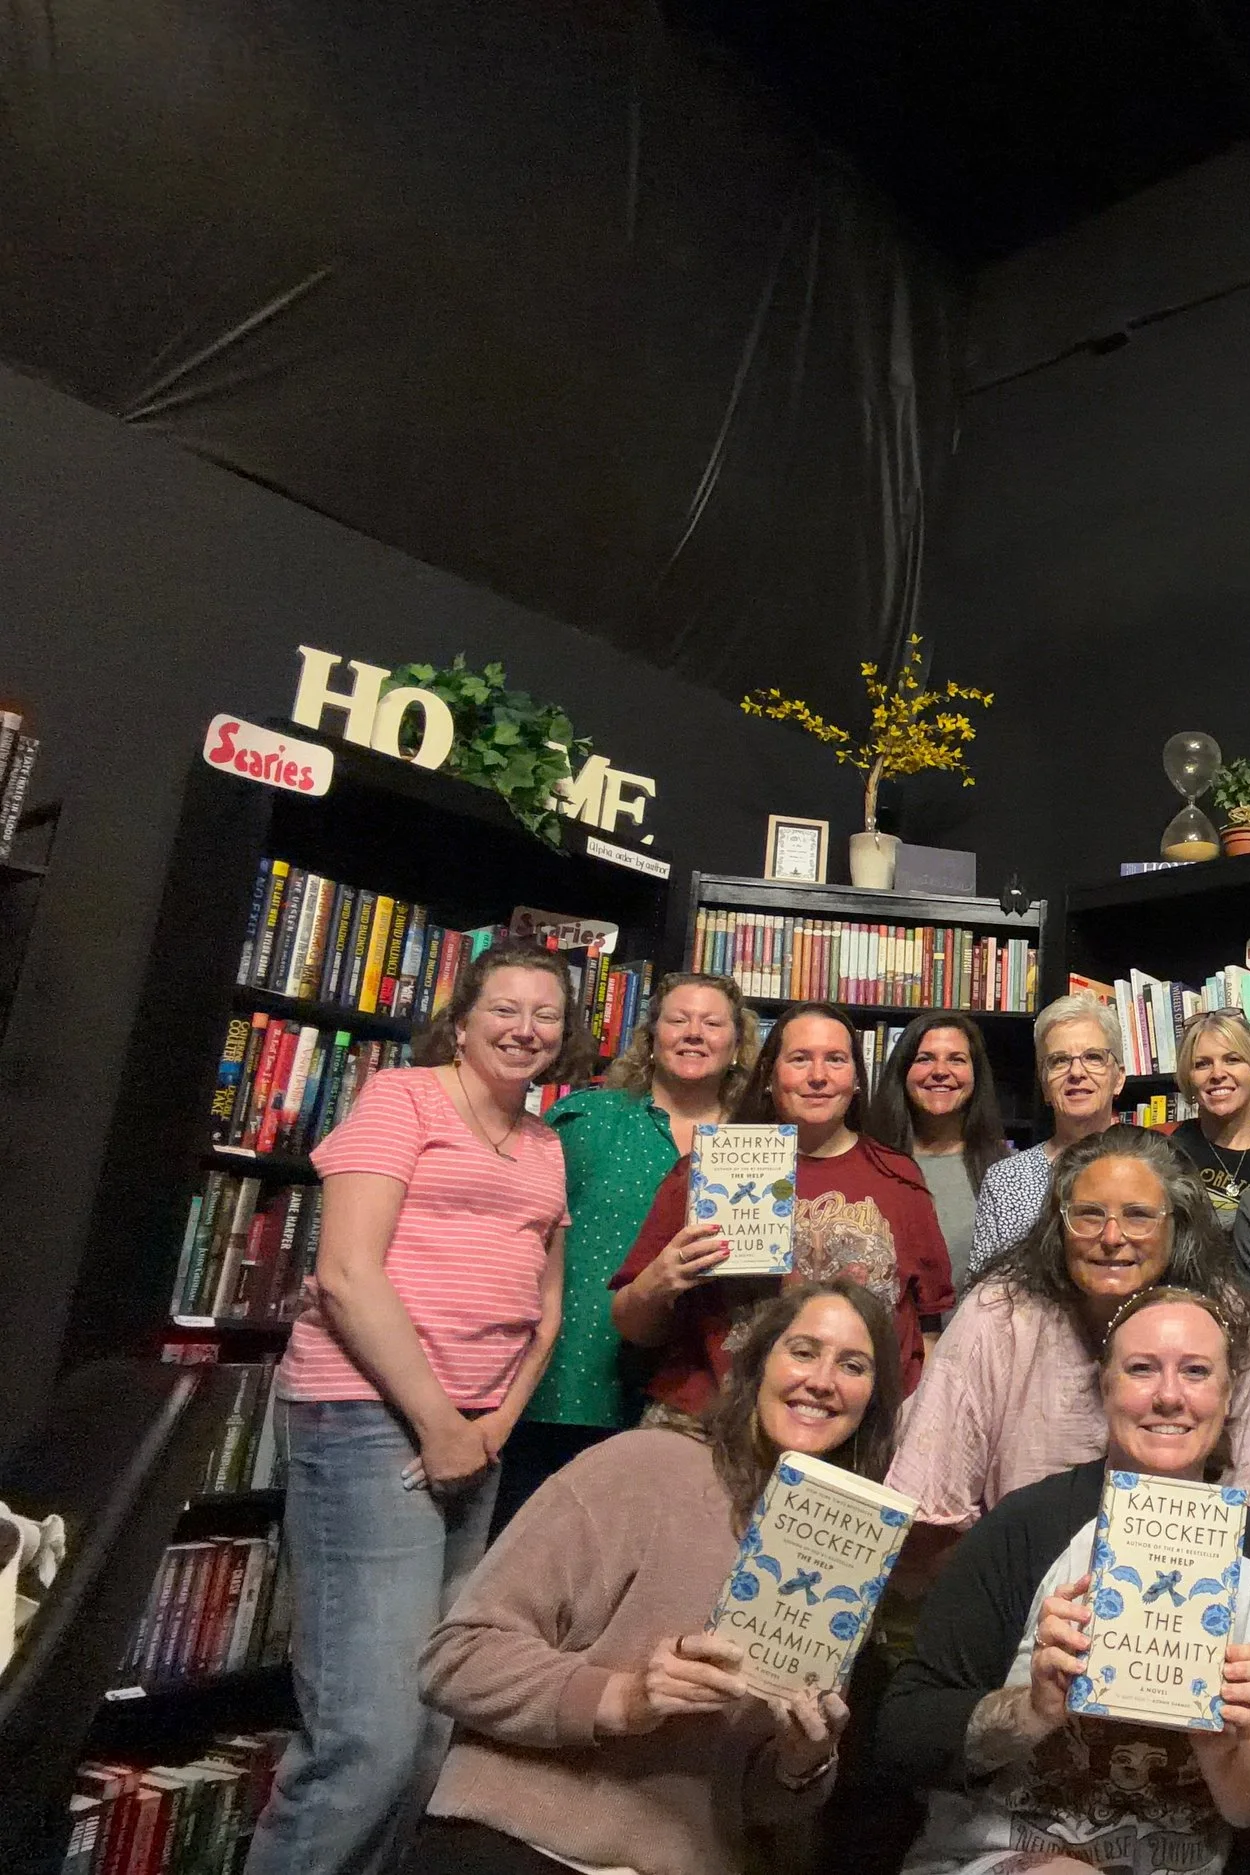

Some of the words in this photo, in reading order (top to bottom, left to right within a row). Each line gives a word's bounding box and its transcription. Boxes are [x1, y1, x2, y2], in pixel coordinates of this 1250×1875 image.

[209, 722, 315, 792] Scaries
[3, 814, 17, 841] BLOOD
[635, 857, 646, 870] by
[246, 902, 261, 935] EXIT
[393, 913, 407, 938] DAVID
[516, 912, 607, 948] Scaries
[355, 928, 369, 957] BALDACCI
[429, 939, 440, 961] DAVID
[386, 937, 404, 976] BALDACCI
[601, 956, 610, 981] HARLAN
[423, 958, 437, 988] BALDACCI
[608, 977, 616, 1000] HARLAN
[1172, 985, 1181, 1014] WHEELS
[1174, 1014, 1182, 1024] OF
[223, 1019, 242, 1062] COULTER
[234, 1021, 251, 1063] CATHERINE
[369, 1044, 381, 1065] JANET
[330, 1076, 340, 1100] FIRST
[210, 1089, 228, 1116] TAKE
[325, 1100, 336, 1116] LIE
[711, 1136, 786, 1149] KATHRYN
[710, 1151, 787, 1165] STOCKETT
[288, 1191, 303, 1214] JANE
[732, 1208, 760, 1220] THE
[280, 1213, 299, 1250] HARPER
[307, 1216, 322, 1253] HARPER
[717, 1223, 785, 1236] ALAMITY
[727, 1239, 764, 1251] CLUB
[214, 1454, 231, 1492] STEPHEN
[784, 1491, 884, 1543] KATHRYN
[1128, 1493, 1229, 1523] KATHRYN
[774, 1514, 877, 1565] STOCKETT
[1123, 1516, 1229, 1548] STOCKETT
[796, 1552, 814, 1564] THE
[813, 1557, 834, 1570] HELP
[1126, 1540, 1153, 1550] AUTHOR
[1163, 1545, 1177, 1553] THE
[1186, 1549, 1221, 1559] BESTSELLER
[1148, 1553, 1168, 1564] THE
[1170, 1556, 1196, 1567] HELP
[774, 1601, 813, 1630] THE
[1144, 1610, 1184, 1633] THE
[730, 1611, 839, 1662] CALAMITY
[1103, 1631, 1218, 1664] CALAMITY
[749, 1642, 800, 1674] CLUB
[1128, 1661, 1184, 1686] CLUB
